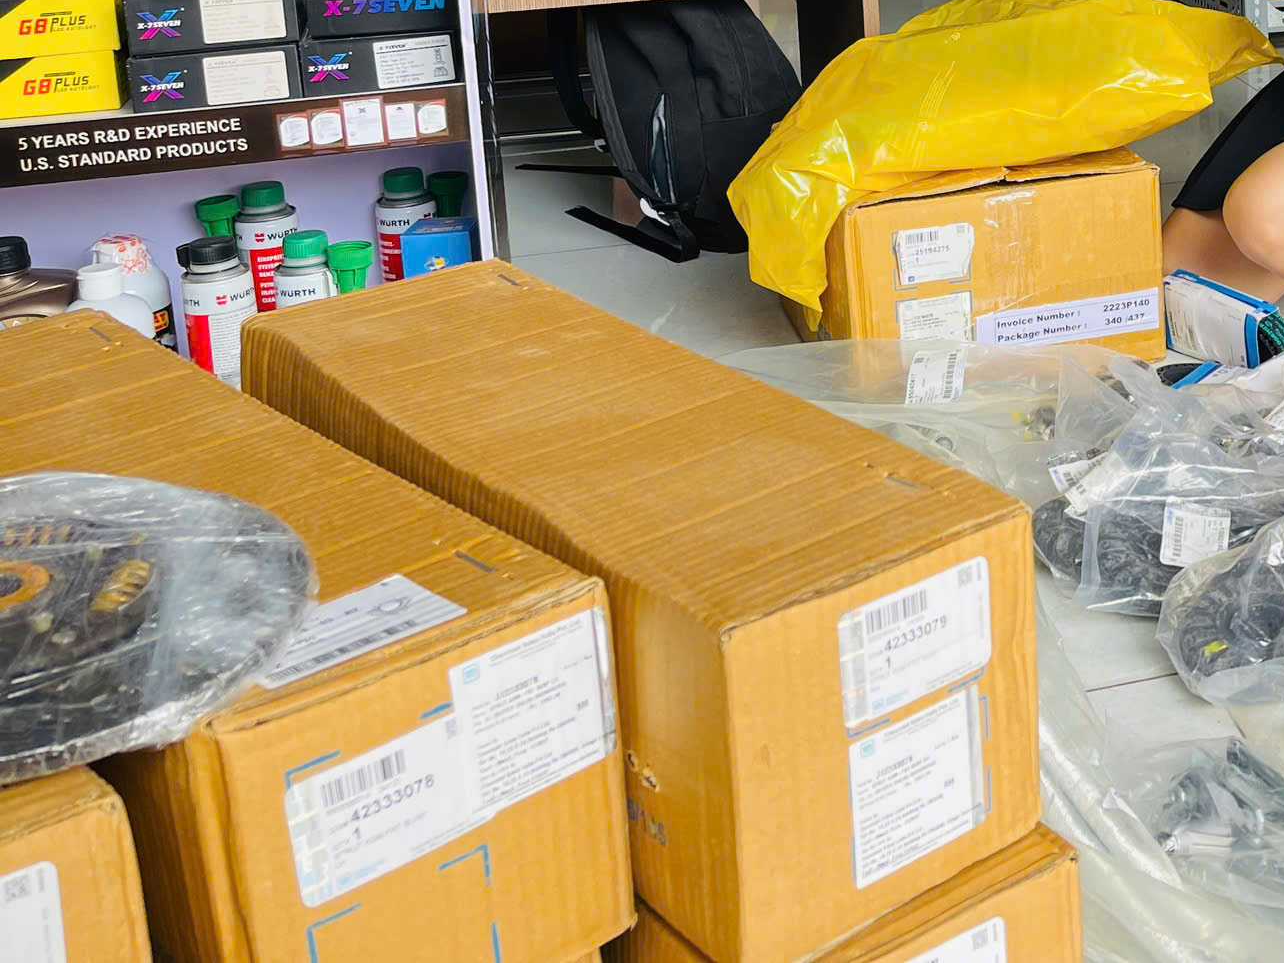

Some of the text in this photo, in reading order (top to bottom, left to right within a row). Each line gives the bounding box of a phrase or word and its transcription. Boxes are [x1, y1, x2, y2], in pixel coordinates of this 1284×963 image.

[18, 14, 86, 36] G8 PLUS
[136, 19, 182, 30] X-7SEVEN
[307, 62, 350, 73] X-7SEVEN
[23, 75, 90, 96] G8 PLUS
[140, 81, 185, 93] X-7SEVEN
[18, 117, 242, 151] 5 YEARS R&D EXPERIENCE
[20, 138, 249, 173] U.S. STANDARD PRODUCTS
[997, 316, 1034, 330] Invoice
[1036, 310, 1075, 323] Number
[1103, 298, 1150, 313] 2223P140
[997, 329, 1041, 344] Package
[1043, 323, 1082, 336] Number
[1104, 316, 1123, 326] 340
[884, 615, 948, 652] 42333079
[351, 773, 436, 823] 42333078
